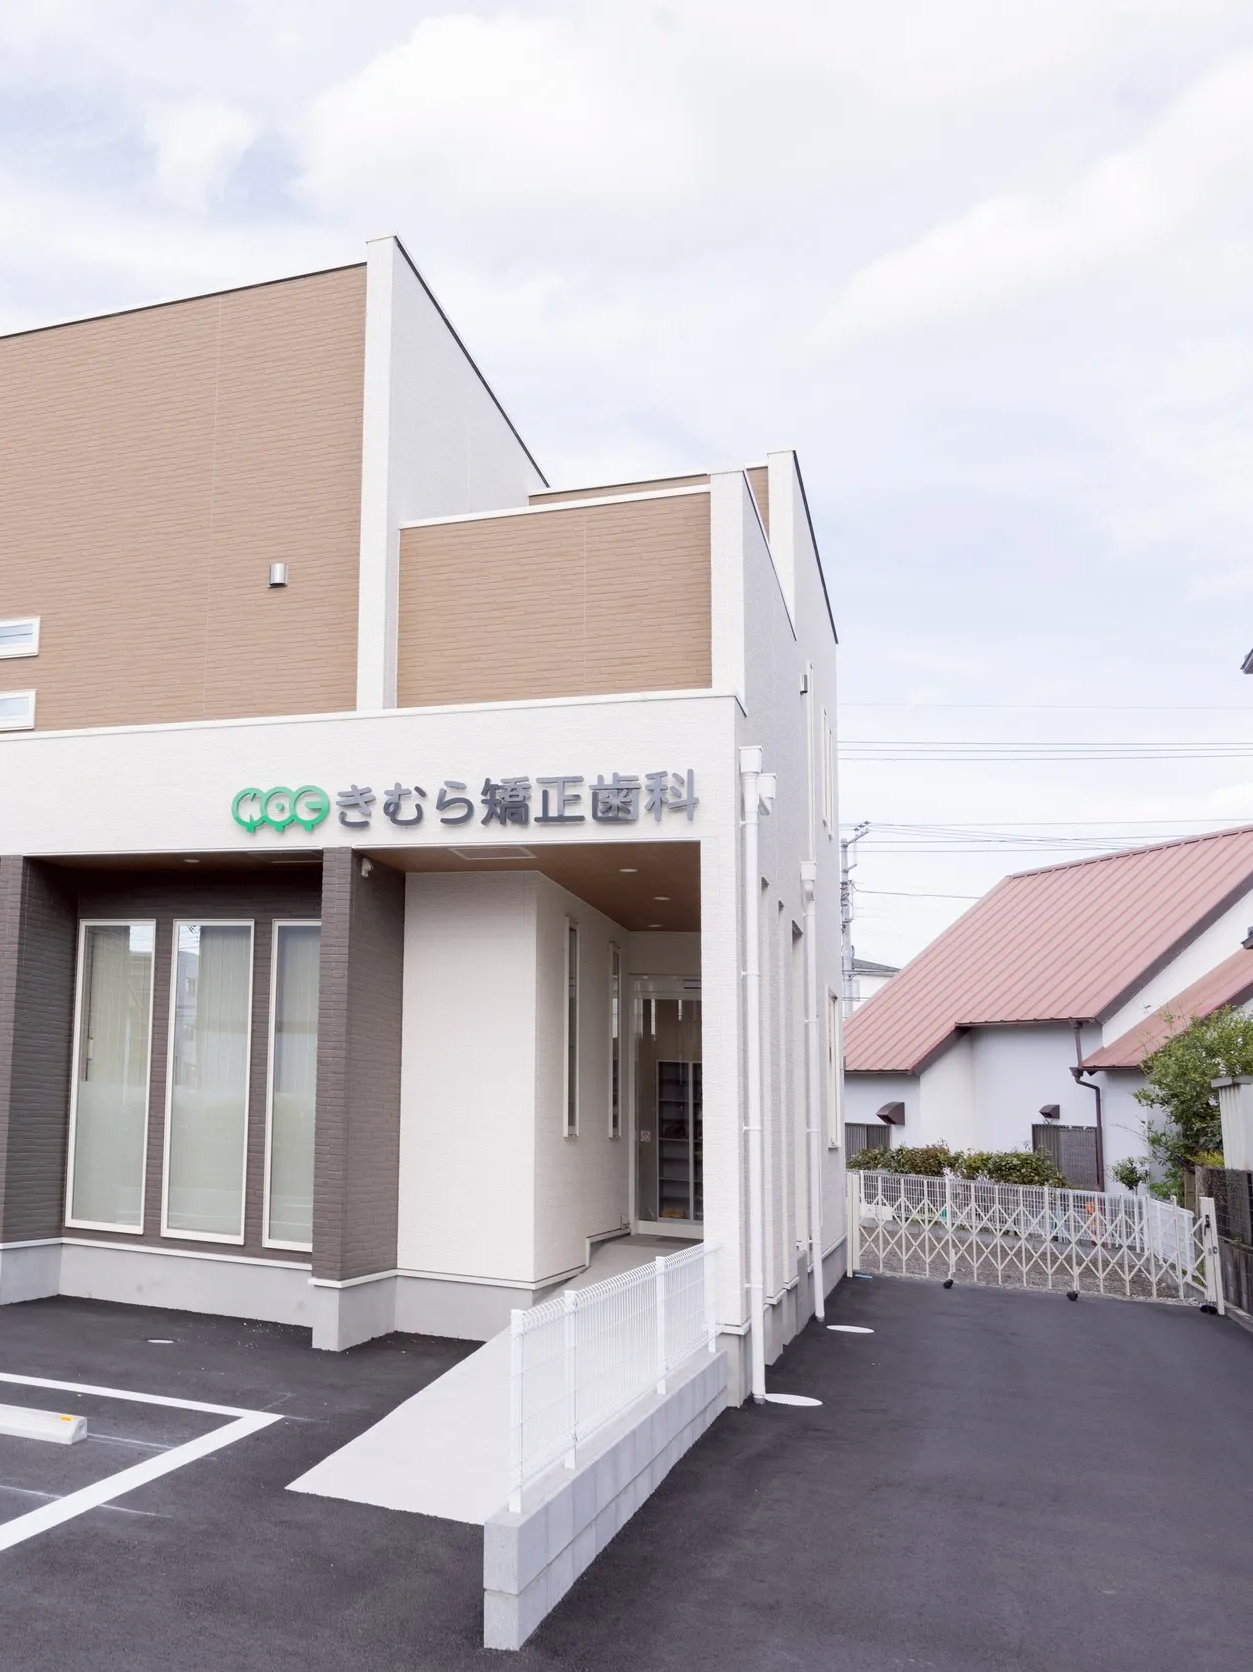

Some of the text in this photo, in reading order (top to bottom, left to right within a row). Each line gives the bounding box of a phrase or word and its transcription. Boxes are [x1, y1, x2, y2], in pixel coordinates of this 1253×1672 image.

[335, 768, 699, 828] きむら矯正歯科
